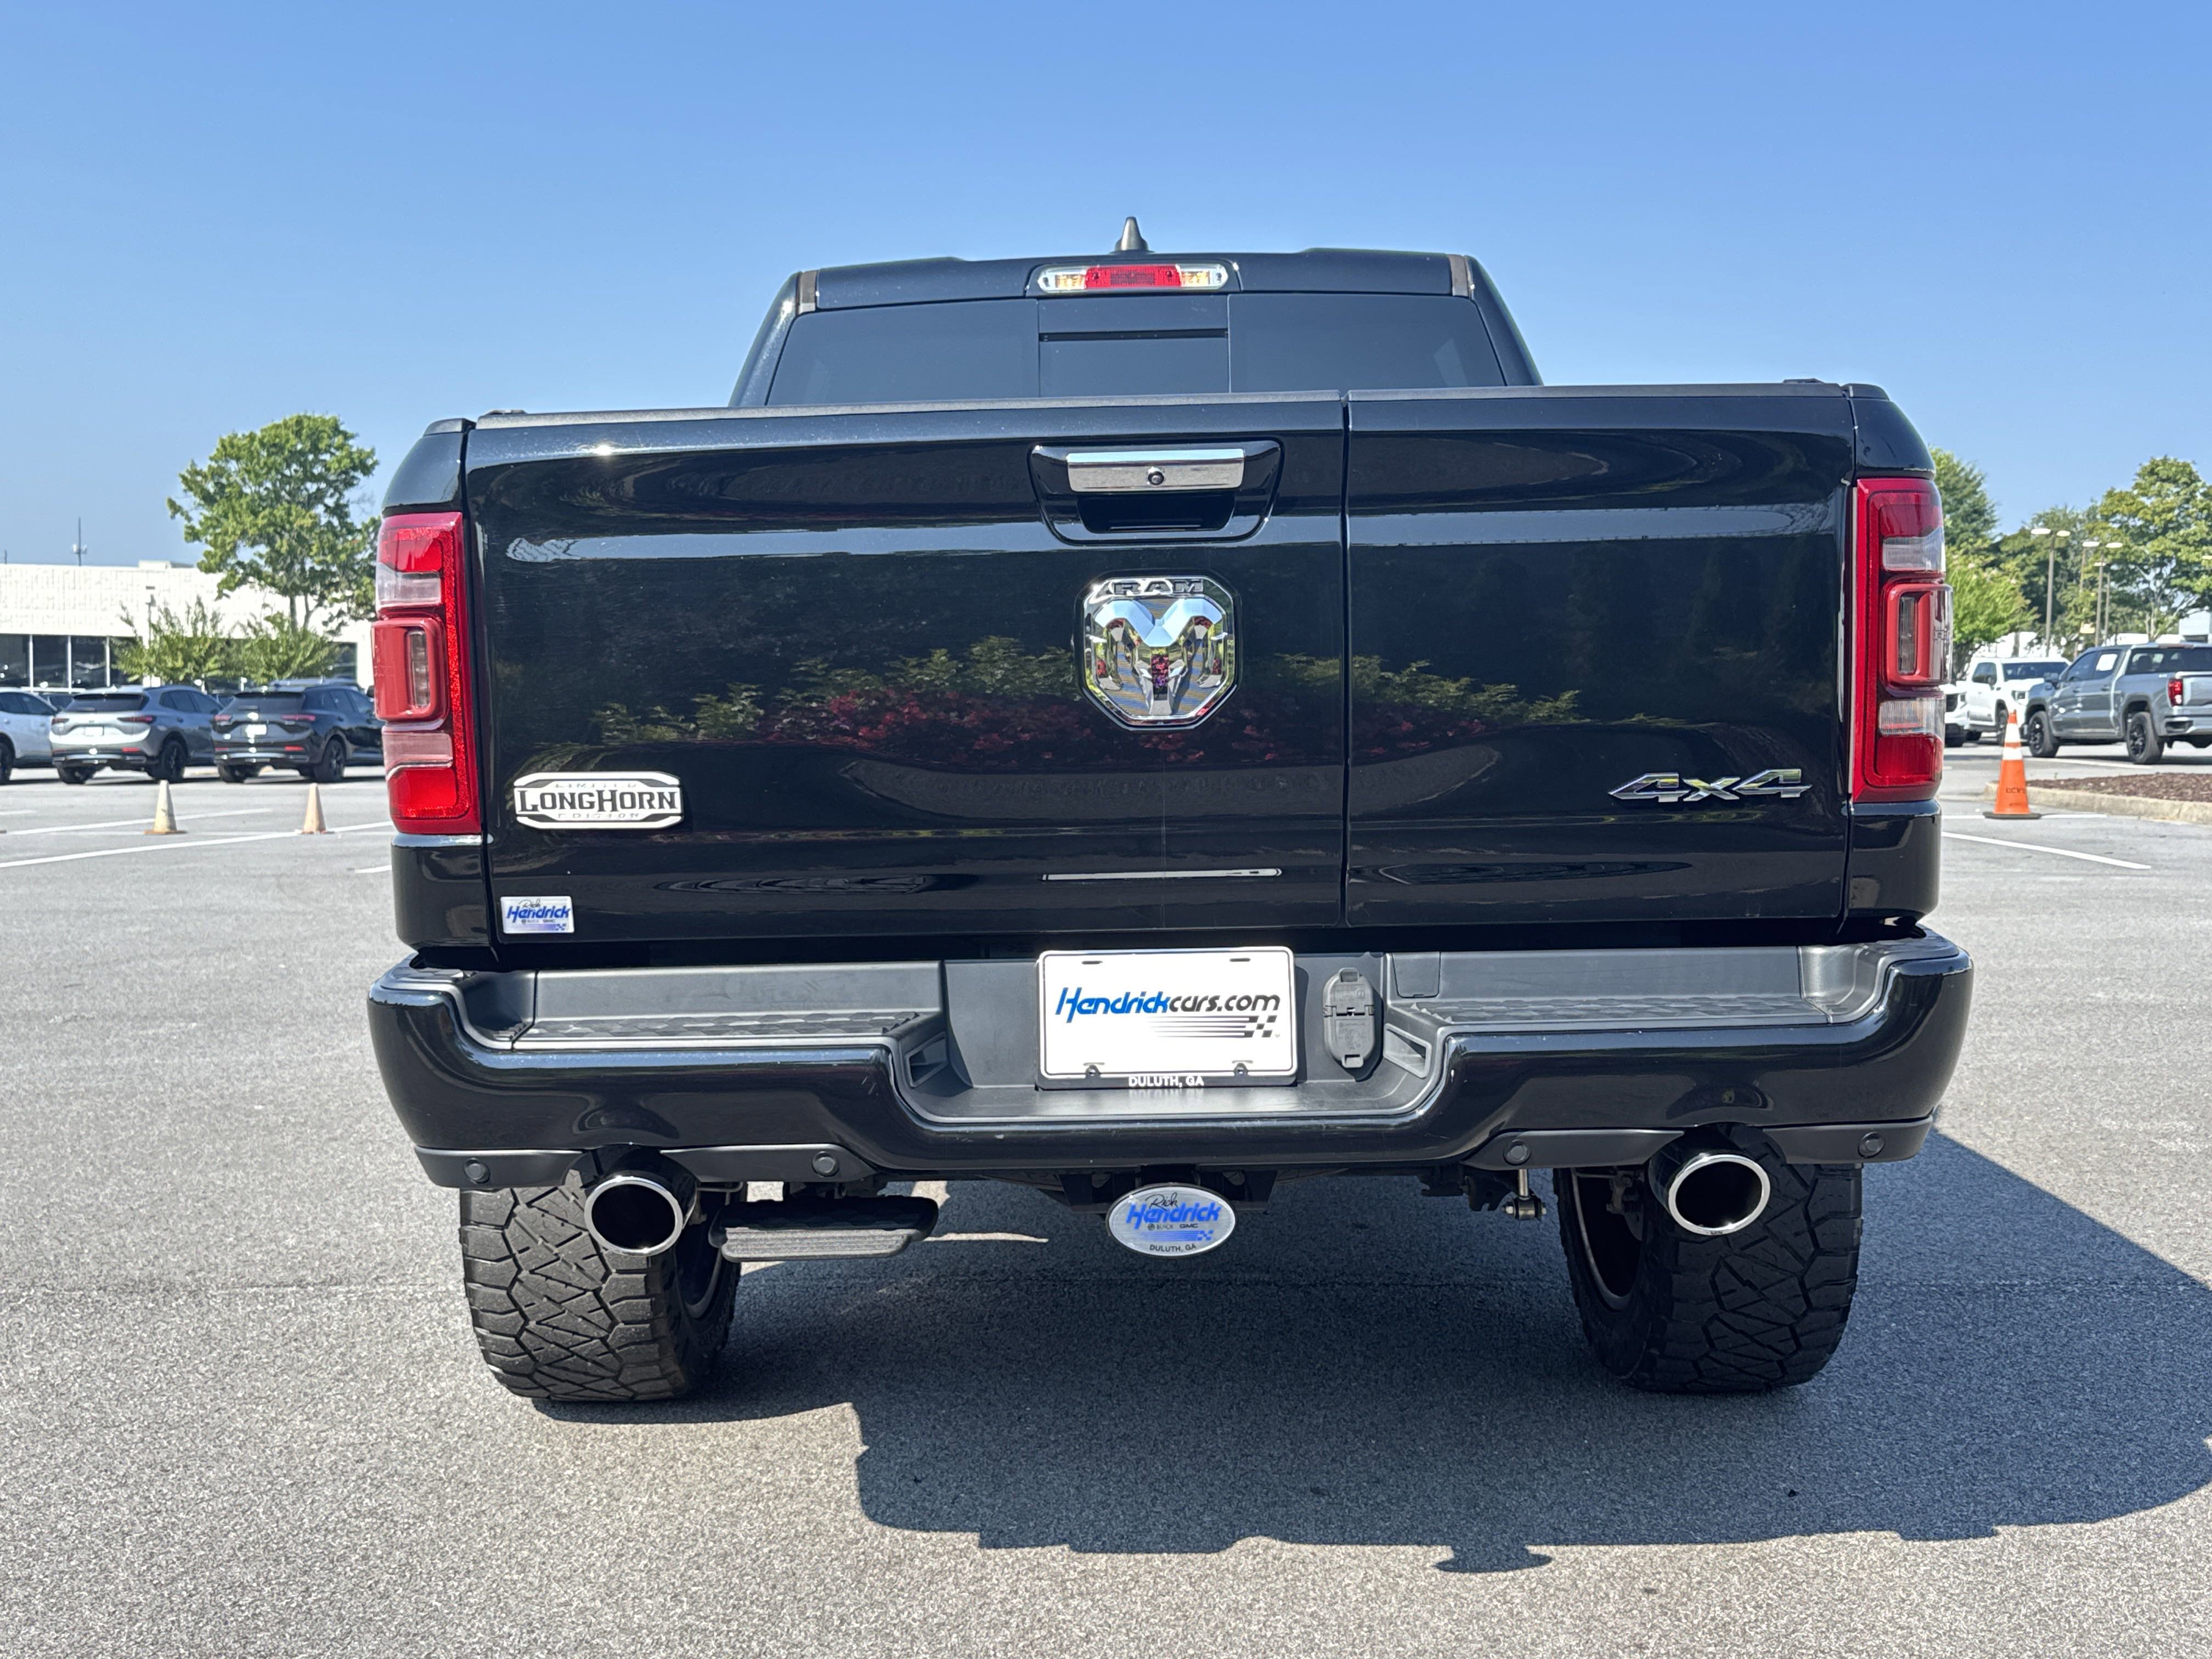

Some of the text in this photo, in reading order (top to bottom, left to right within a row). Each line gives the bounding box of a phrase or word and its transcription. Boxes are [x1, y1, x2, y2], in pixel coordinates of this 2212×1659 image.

[1111, 579, 1204, 595] RAM
[517, 789, 679, 812] LONGHORN
[506, 906, 571, 923] Hendrick
[1055, 987, 1280, 1023] Hendrickcars.com
[1128, 1075, 1204, 1088] DULUTH, GA
[1145, 1192, 1178, 1211] Rick
[1126, 1202, 1222, 1229] Hendrick
[1149, 1243, 1197, 1252] DULUTH, GA
